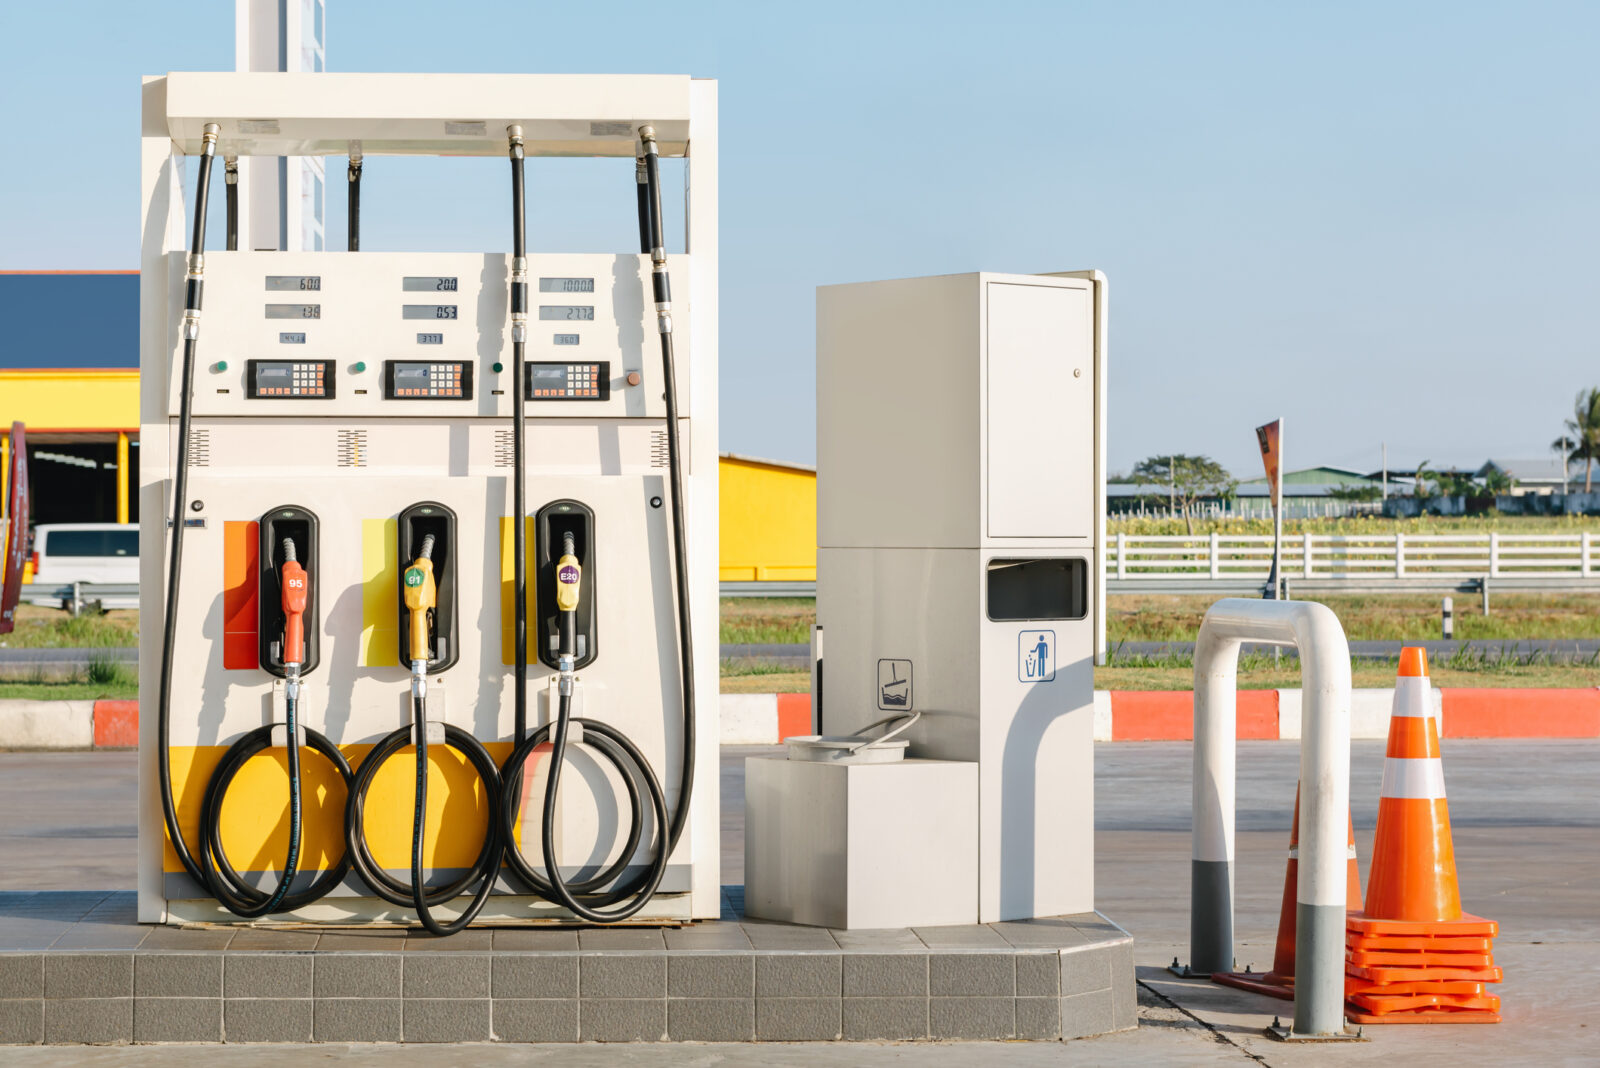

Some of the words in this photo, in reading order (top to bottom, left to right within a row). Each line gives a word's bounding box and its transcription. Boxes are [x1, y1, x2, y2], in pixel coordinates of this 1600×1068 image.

[408, 575, 421, 585] 91
[560, 572, 577, 583] E20
[288, 579, 303, 588] 95
